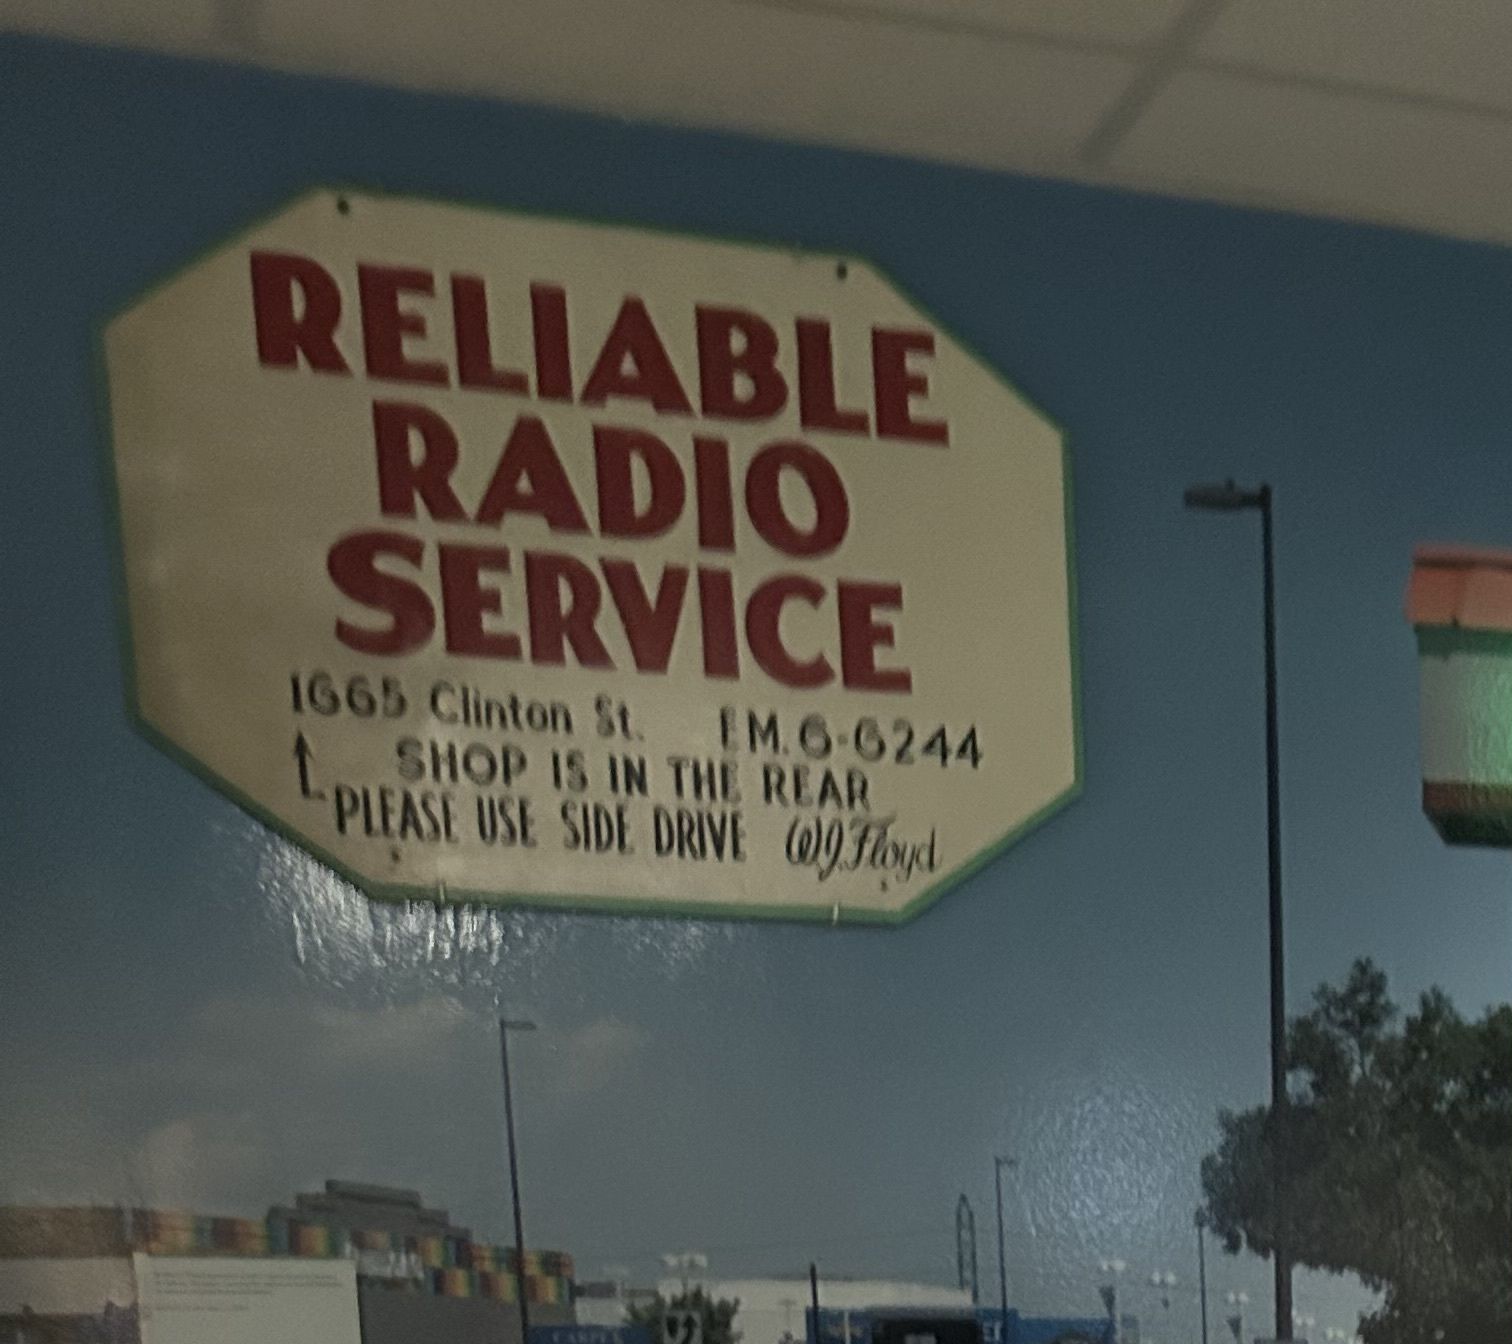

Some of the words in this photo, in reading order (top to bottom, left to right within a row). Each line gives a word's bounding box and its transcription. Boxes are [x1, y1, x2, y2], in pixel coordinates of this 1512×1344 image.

[250, 250, 949, 447] RELIABLE
[371, 399, 850, 558] RADIO
[325, 529, 913, 694] SERVICE
[430, 679, 574, 735] Clinton
[594, 690, 645, 742] St.
[335, 784, 460, 844] PLEASE
[477, 794, 539, 849] USE
[561, 799, 635, 856] SIDE
[653, 803, 747, 862] DRIVE
[396, 737, 527, 787] SHOP
[552, 749, 589, 793] IS
[608, 752, 648, 798] IN
[666, 755, 741, 804] THE
[762, 762, 870, 811] REAR
